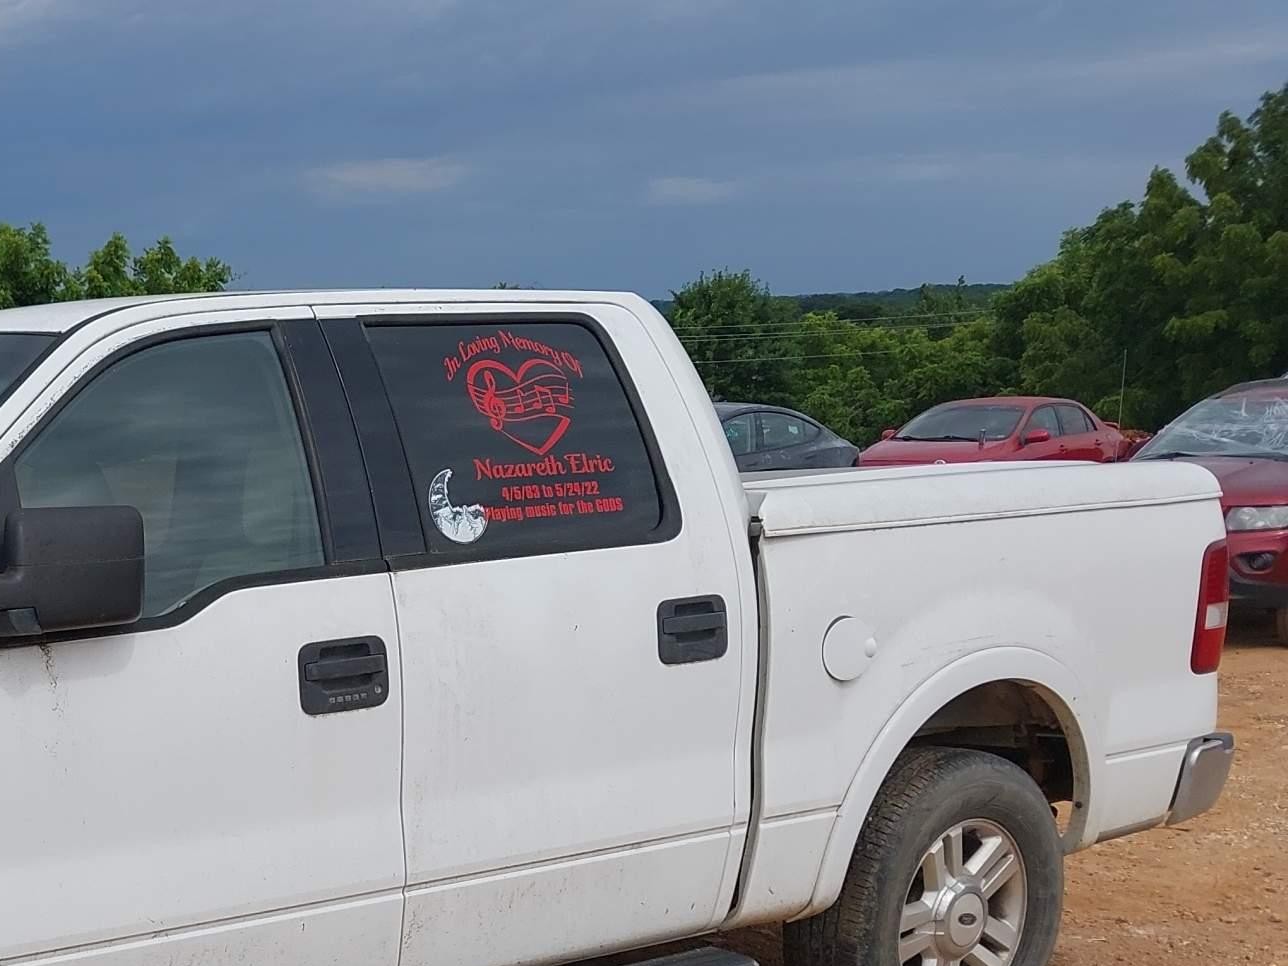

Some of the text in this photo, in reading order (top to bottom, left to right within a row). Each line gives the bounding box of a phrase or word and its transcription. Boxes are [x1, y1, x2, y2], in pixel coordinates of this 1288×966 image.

[443, 329, 584, 382] In Loving Memory Of
[472, 452, 616, 481] Nazareth Elric
[541, 484, 553, 498] to
[554, 480, 600, 497] 5/24/22
[484, 497, 624, 523] Playing music for the GODS
